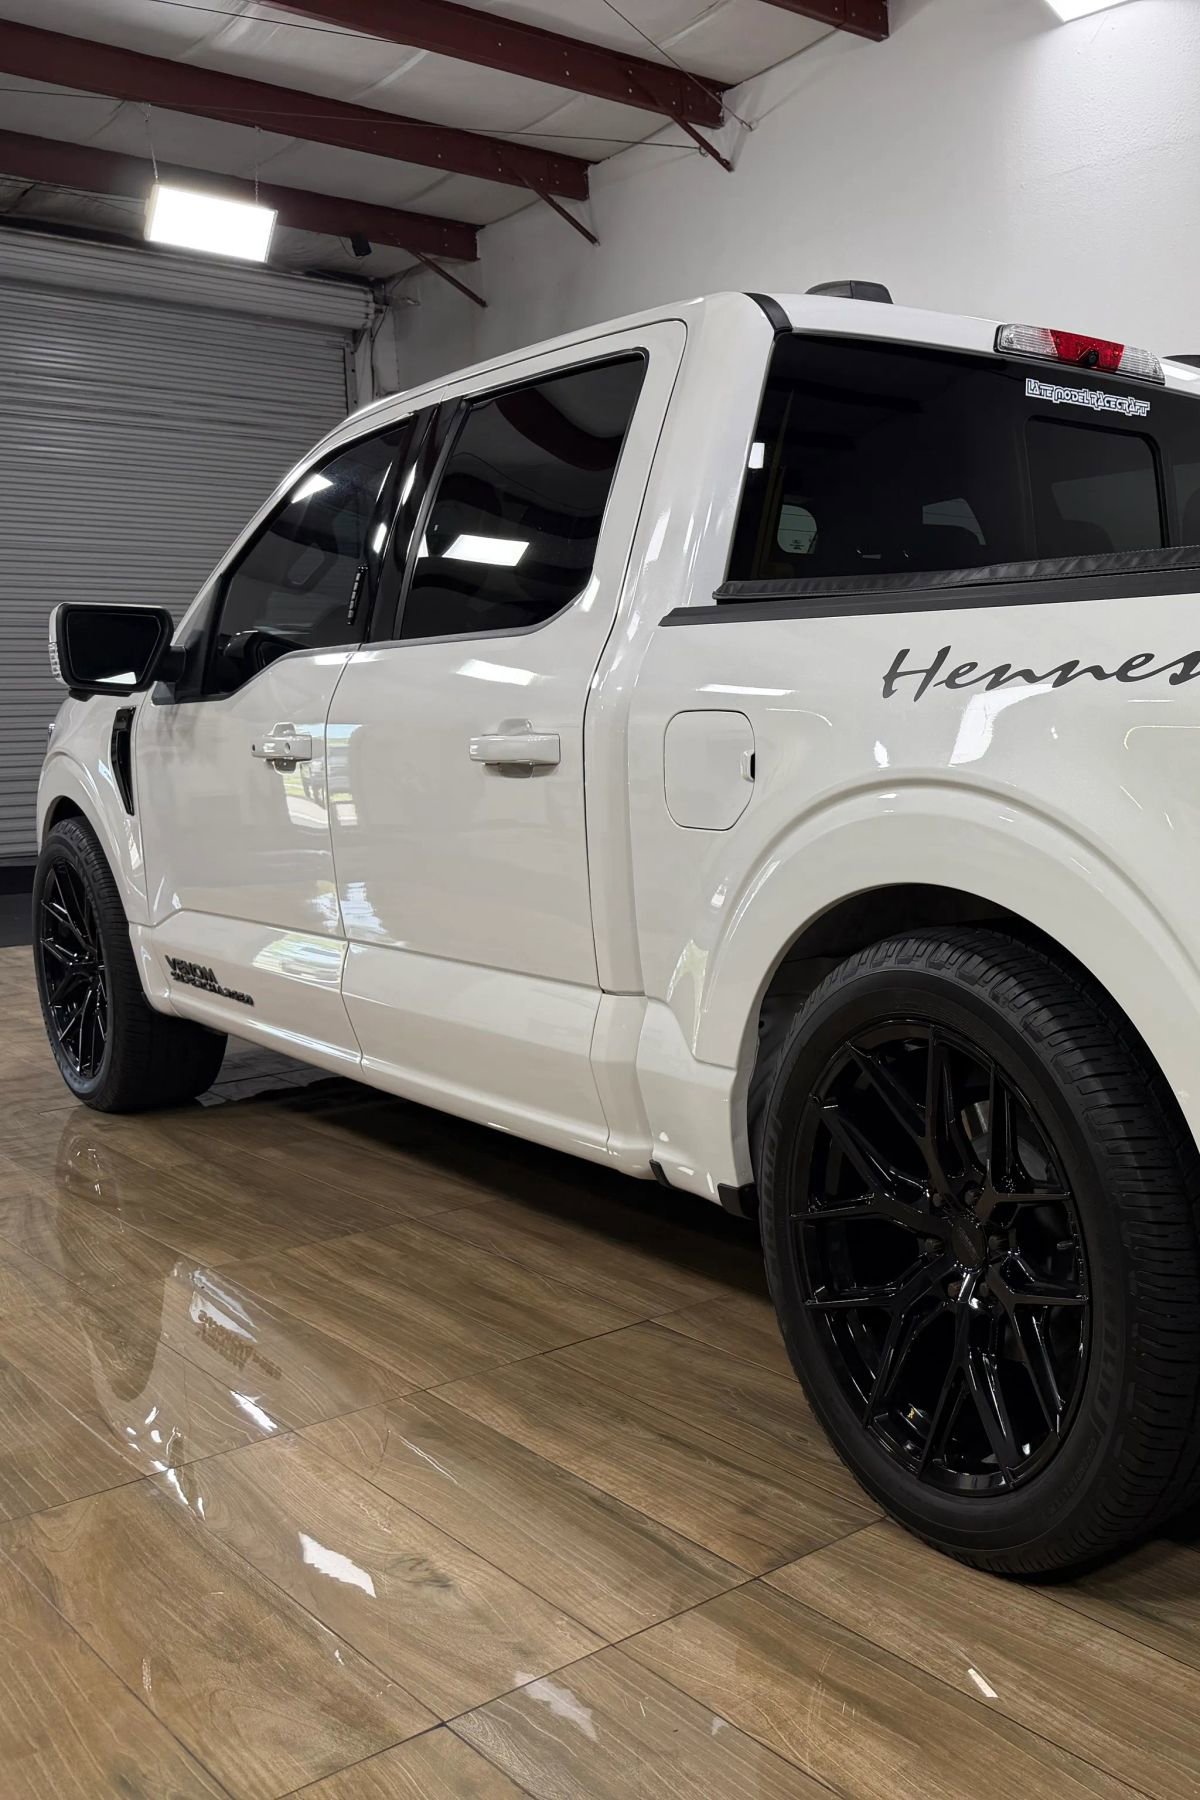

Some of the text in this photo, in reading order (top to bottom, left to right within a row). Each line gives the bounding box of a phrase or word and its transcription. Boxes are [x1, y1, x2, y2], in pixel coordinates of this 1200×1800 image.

[1026, 378, 1150, 416] LATE MODEL RACECRAFT
[164, 954, 218, 984] VENOM
